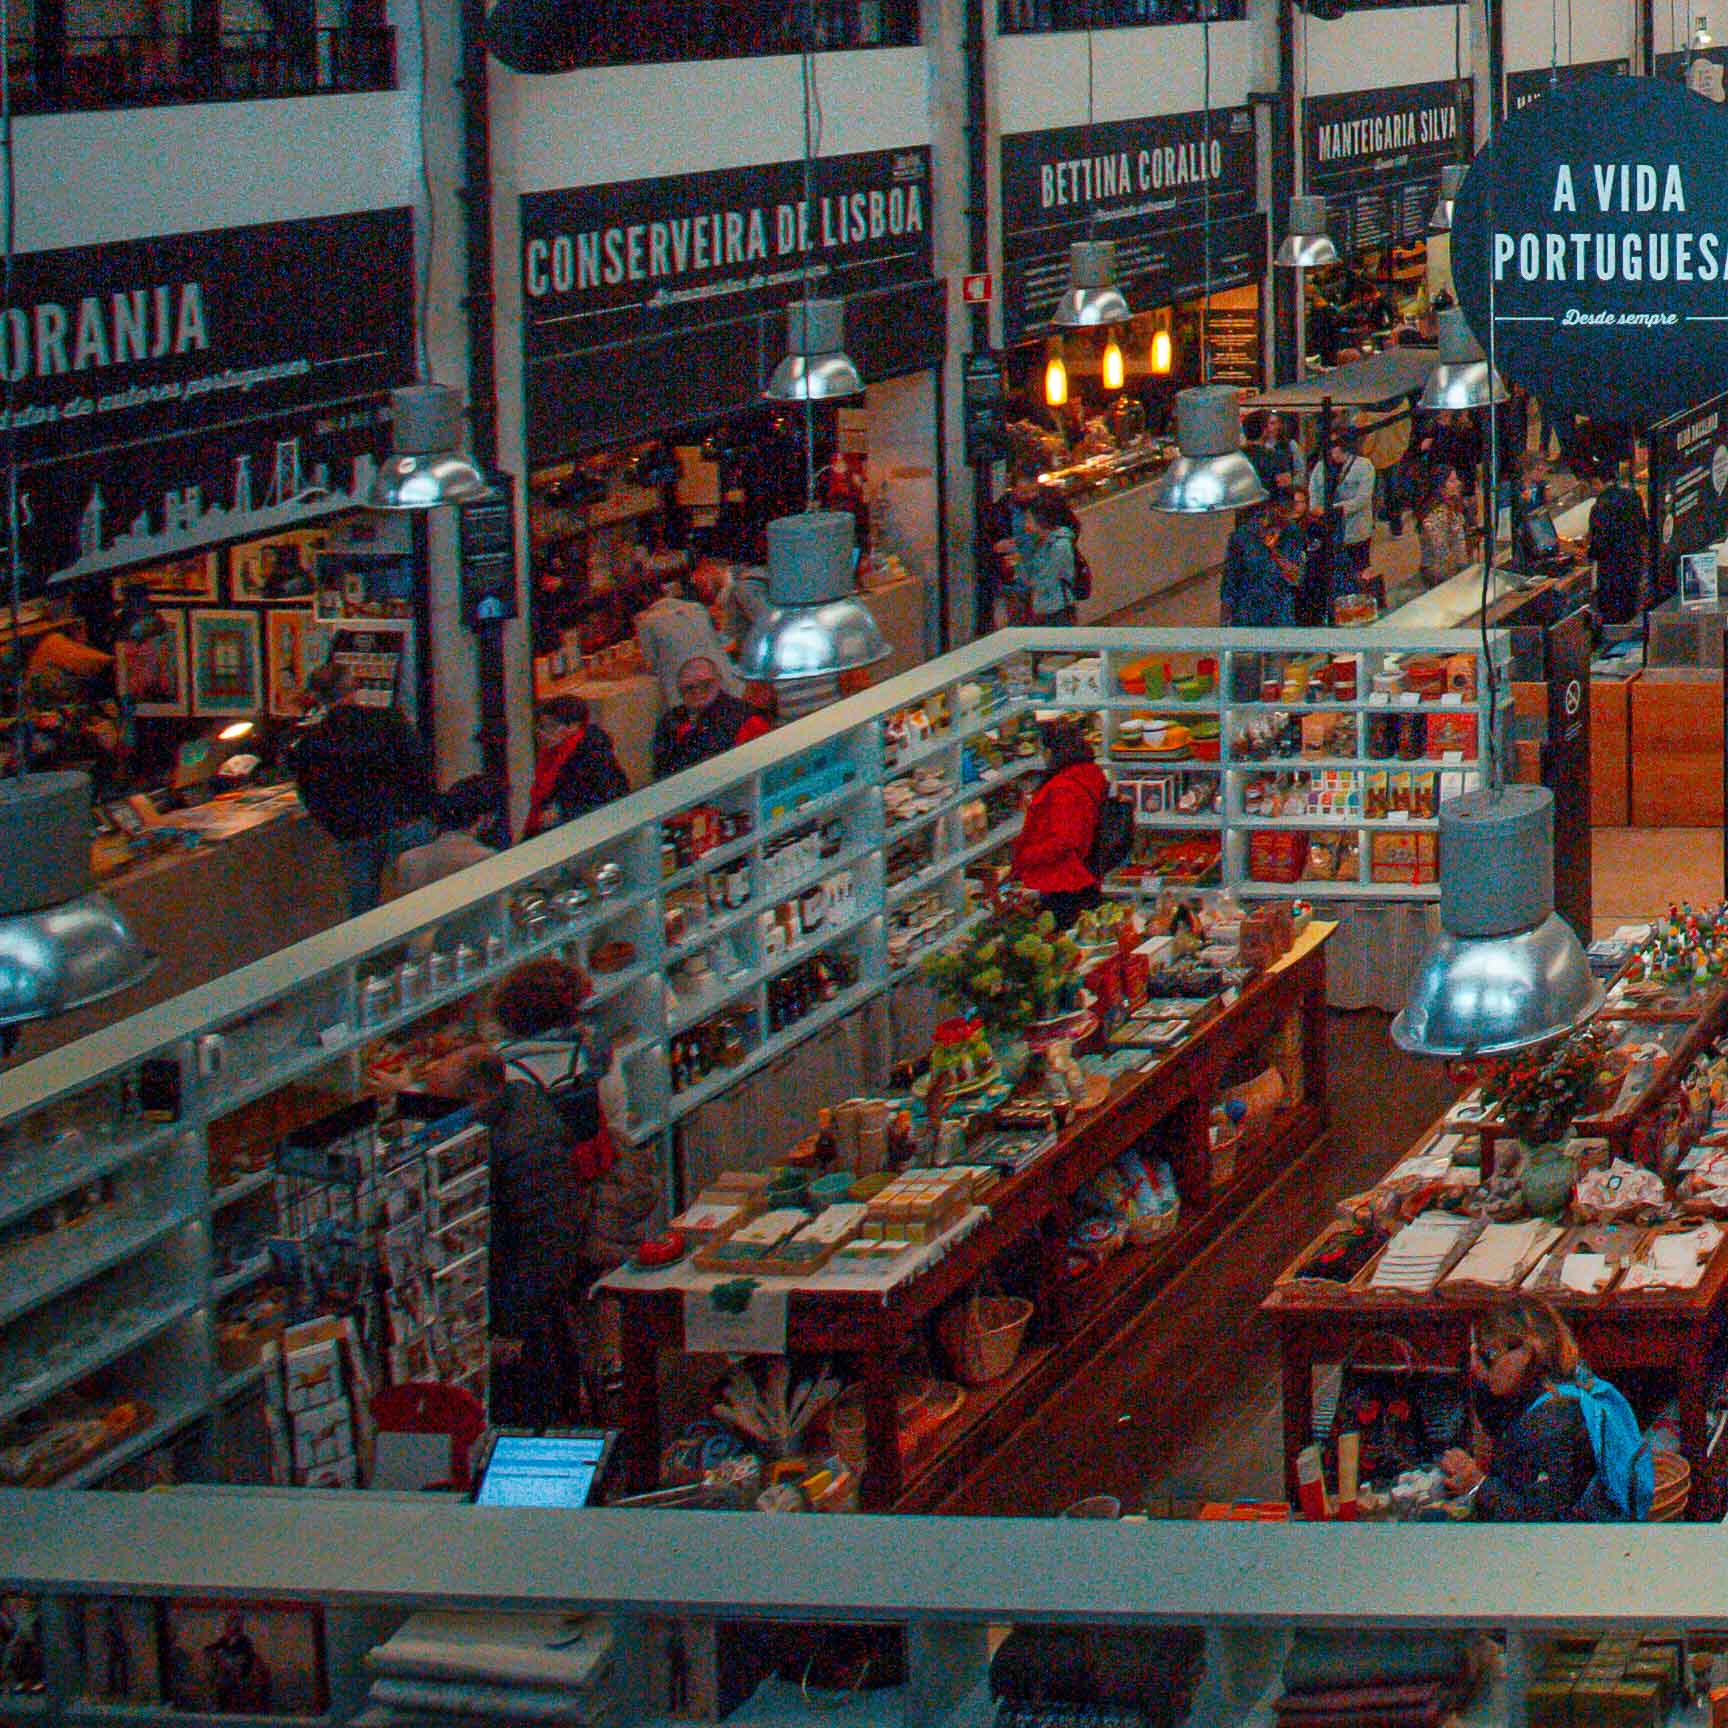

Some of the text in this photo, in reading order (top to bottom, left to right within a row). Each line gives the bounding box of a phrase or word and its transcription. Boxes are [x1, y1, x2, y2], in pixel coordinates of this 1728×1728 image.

[1318, 106, 1458, 162] MANTEIGARIA SILVA
[1041, 153, 1132, 209] BETTINA
[1137, 139, 1222, 191] CORALLO
[1553, 165, 1686, 211] A VIDA
[526, 208, 768, 298] CONSERVEIRA
[776, 201, 814, 256] DE
[819, 183, 923, 248] LISBOA
[1561, 308, 1678, 328] Desde sempre
